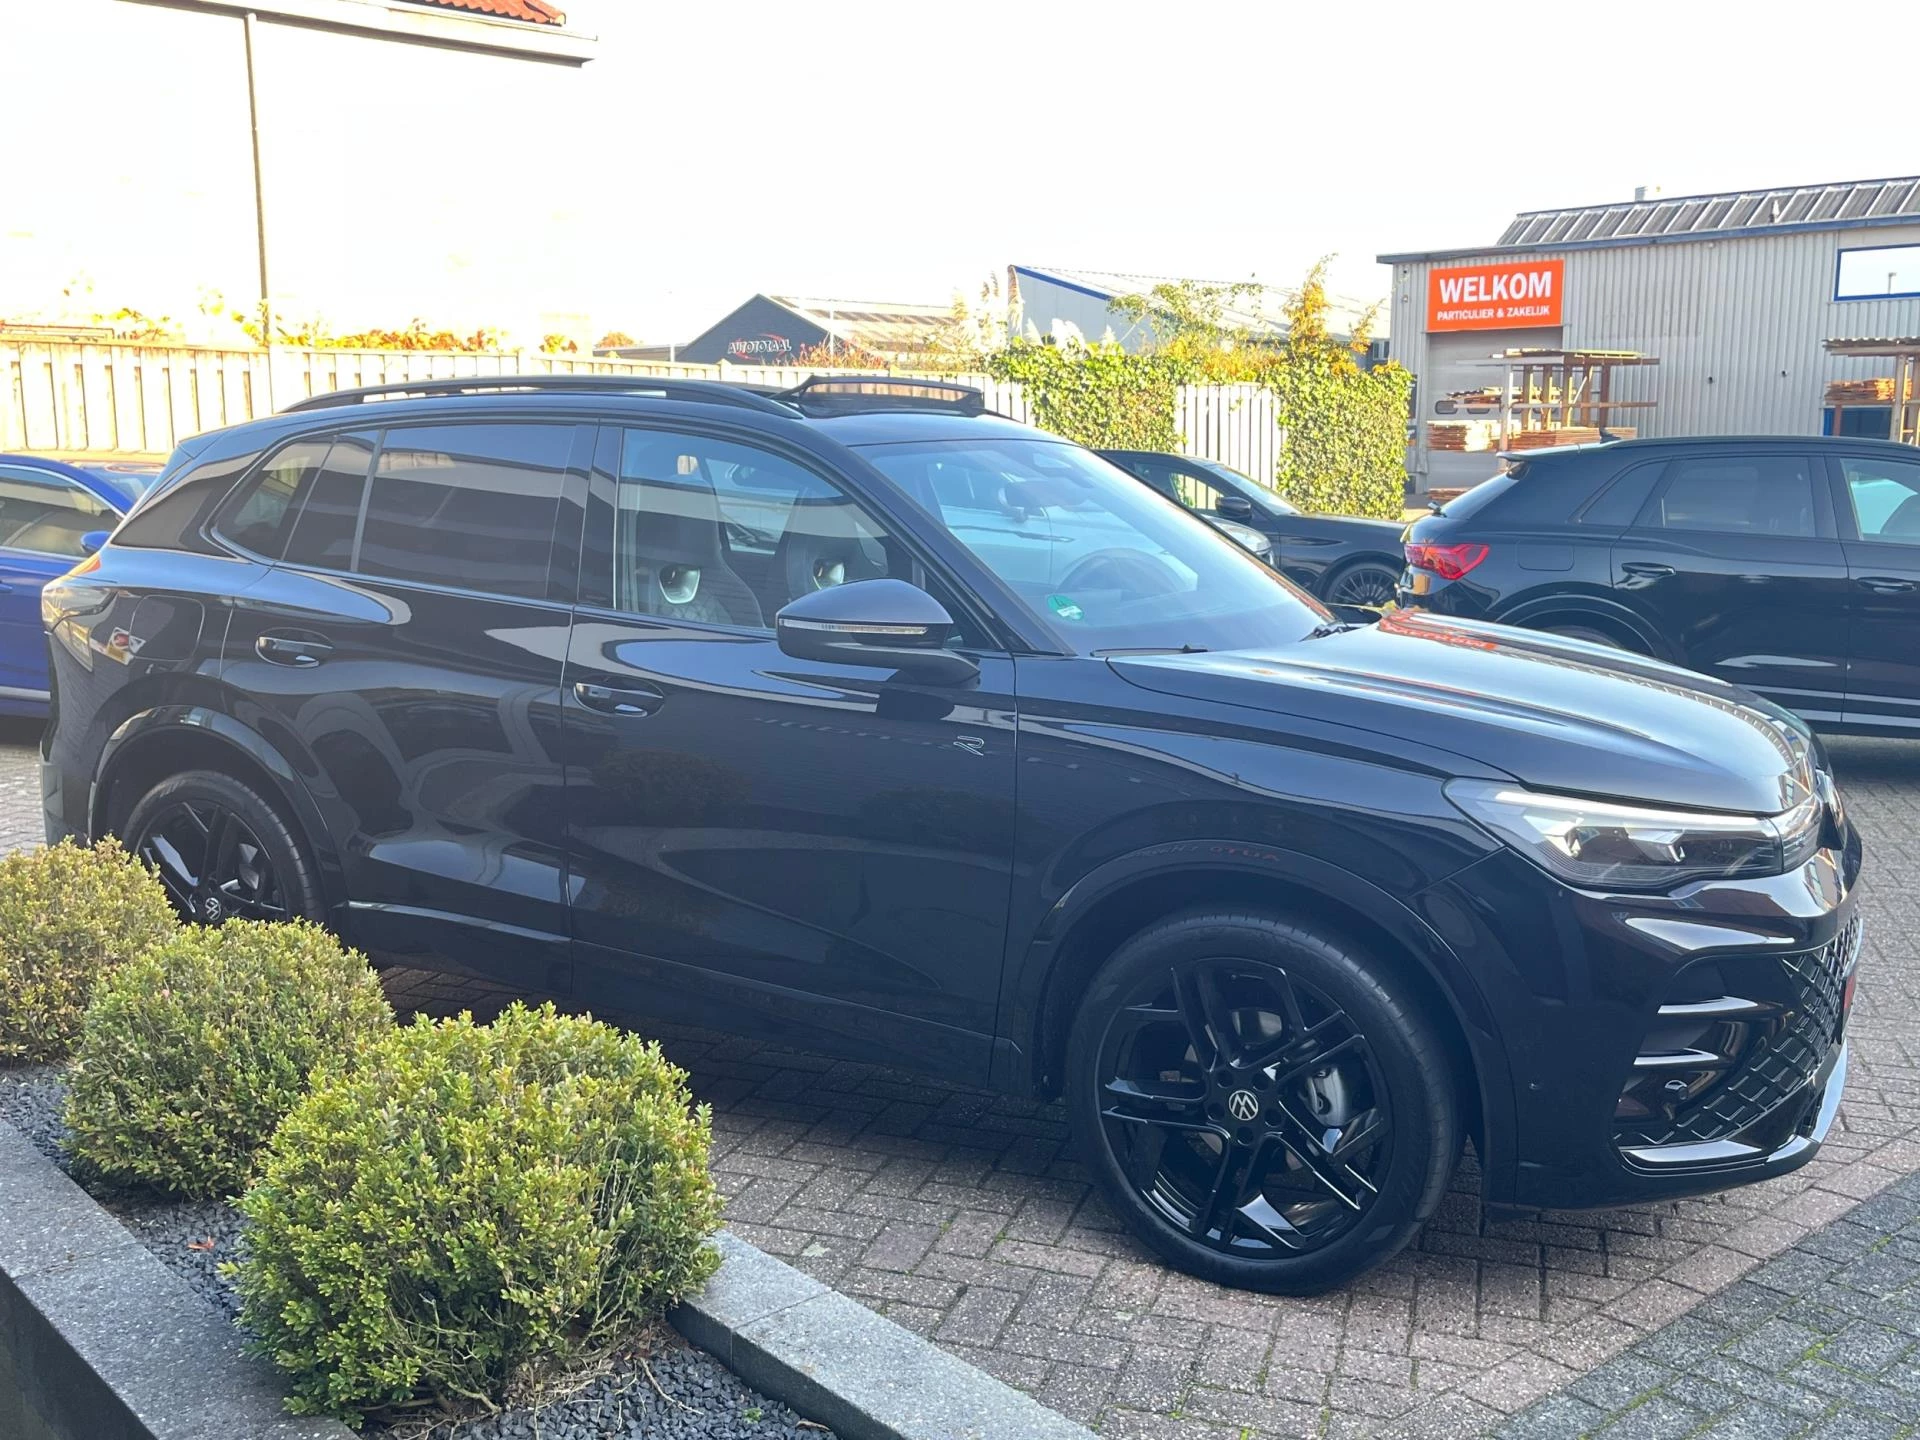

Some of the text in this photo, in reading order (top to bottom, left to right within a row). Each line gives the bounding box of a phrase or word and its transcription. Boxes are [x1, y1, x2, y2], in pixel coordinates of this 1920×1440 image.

[1439, 271, 1552, 304] WELKOM
[1437, 305, 1550, 321] PARTICULIER & ZAKELIJK
[728, 339, 792, 354] AUTOTOTAAL
